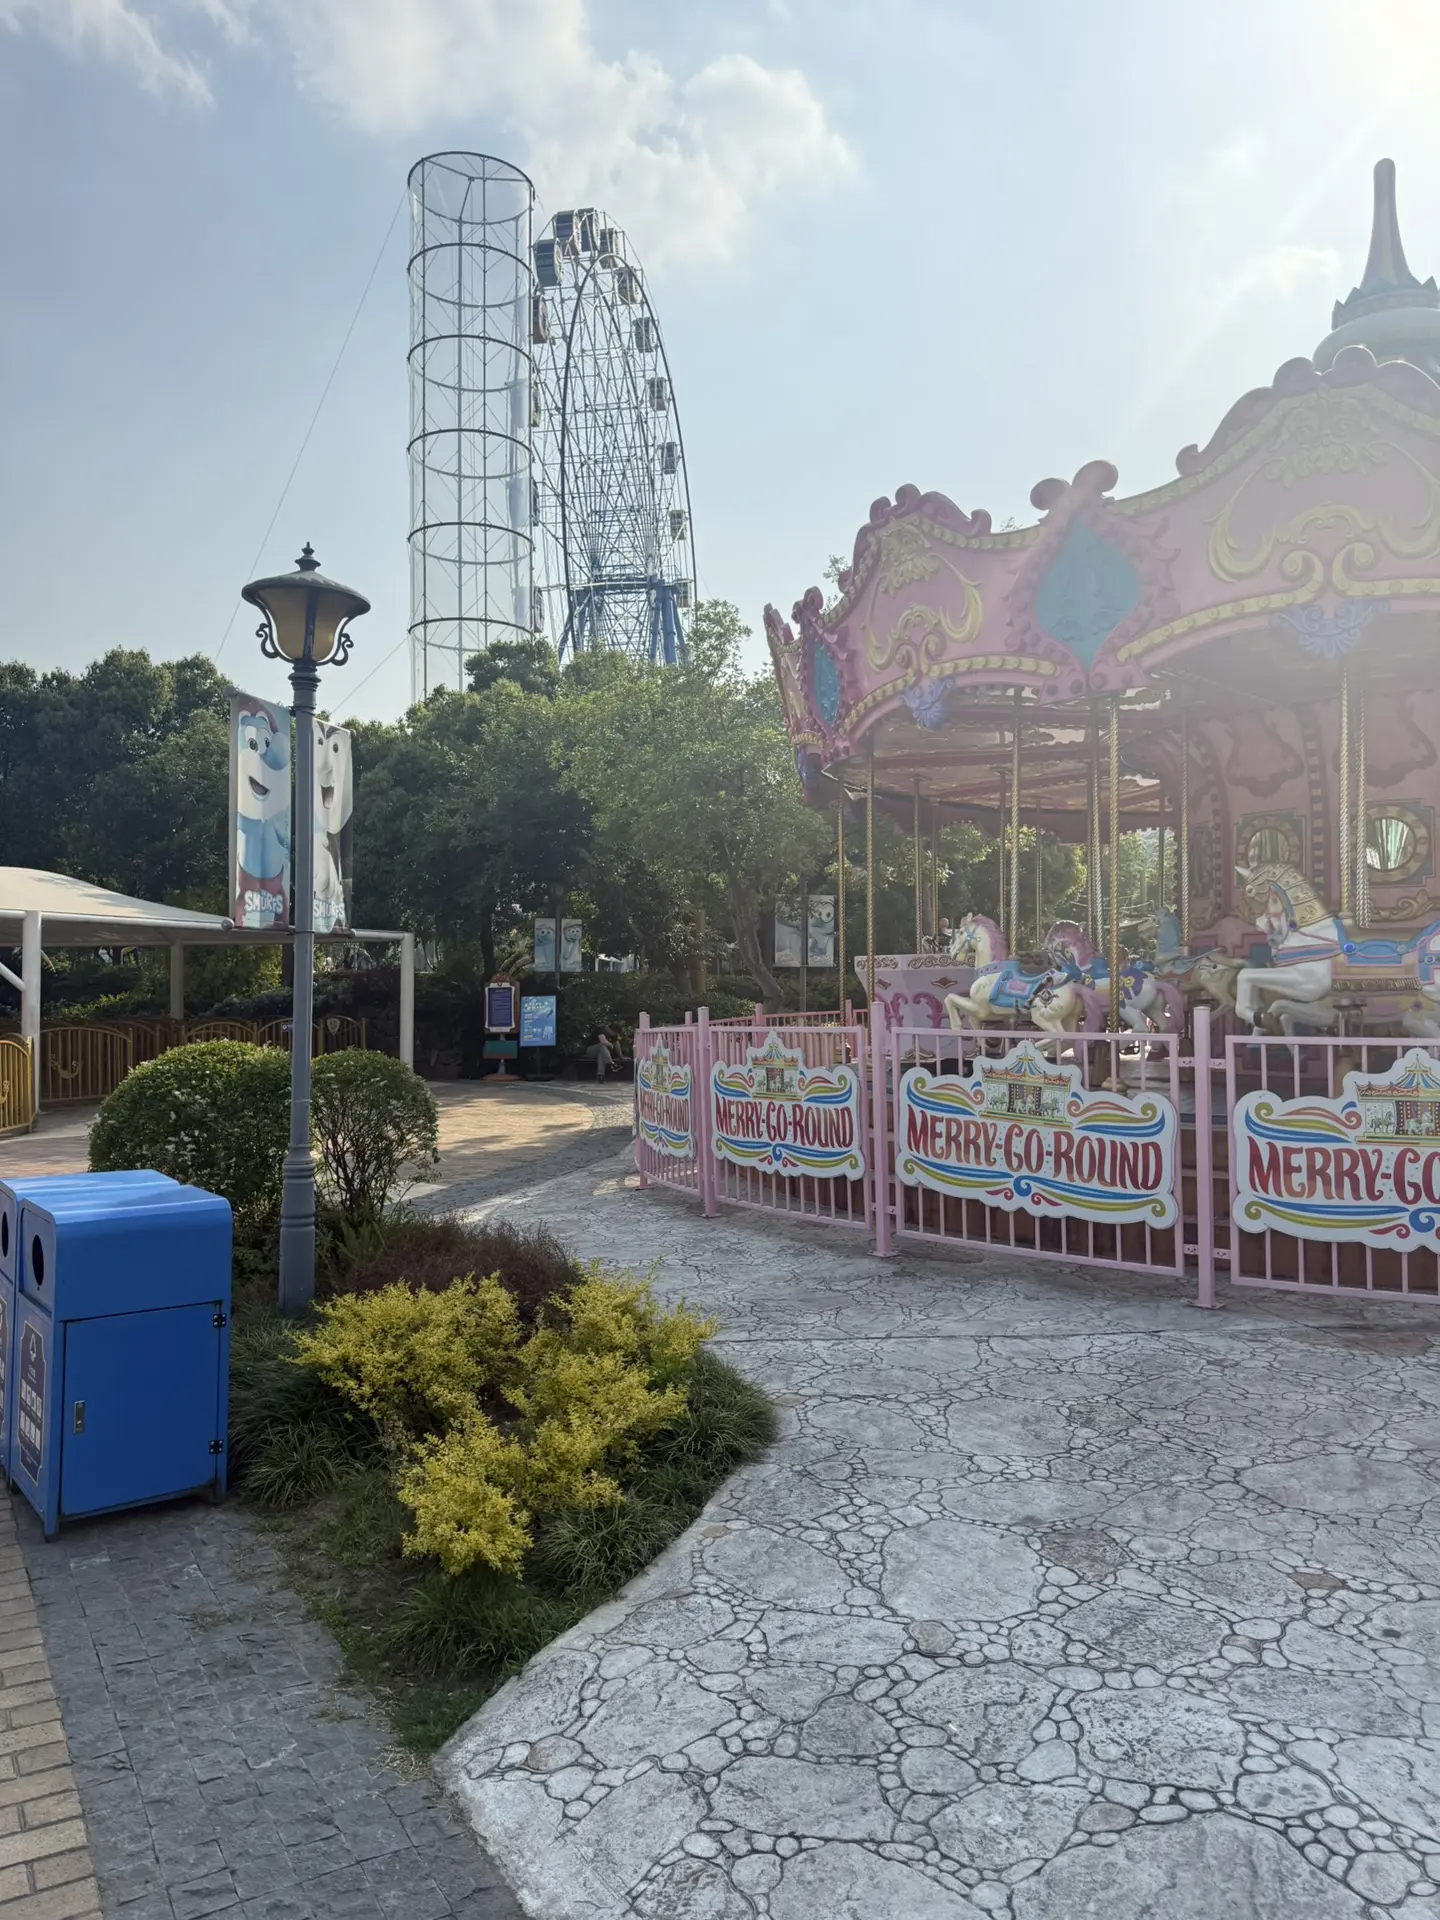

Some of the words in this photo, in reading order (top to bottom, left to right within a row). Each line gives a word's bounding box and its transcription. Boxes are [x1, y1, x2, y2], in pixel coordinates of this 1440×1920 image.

[244, 889, 283, 915] SMURFS
[640, 1089, 690, 1133] MERRY-GO-ROUND
[714, 1092, 854, 1149] MERRY-GO-ROUND
[907, 1103, 1163, 1191] MERRY-GO-ROUND
